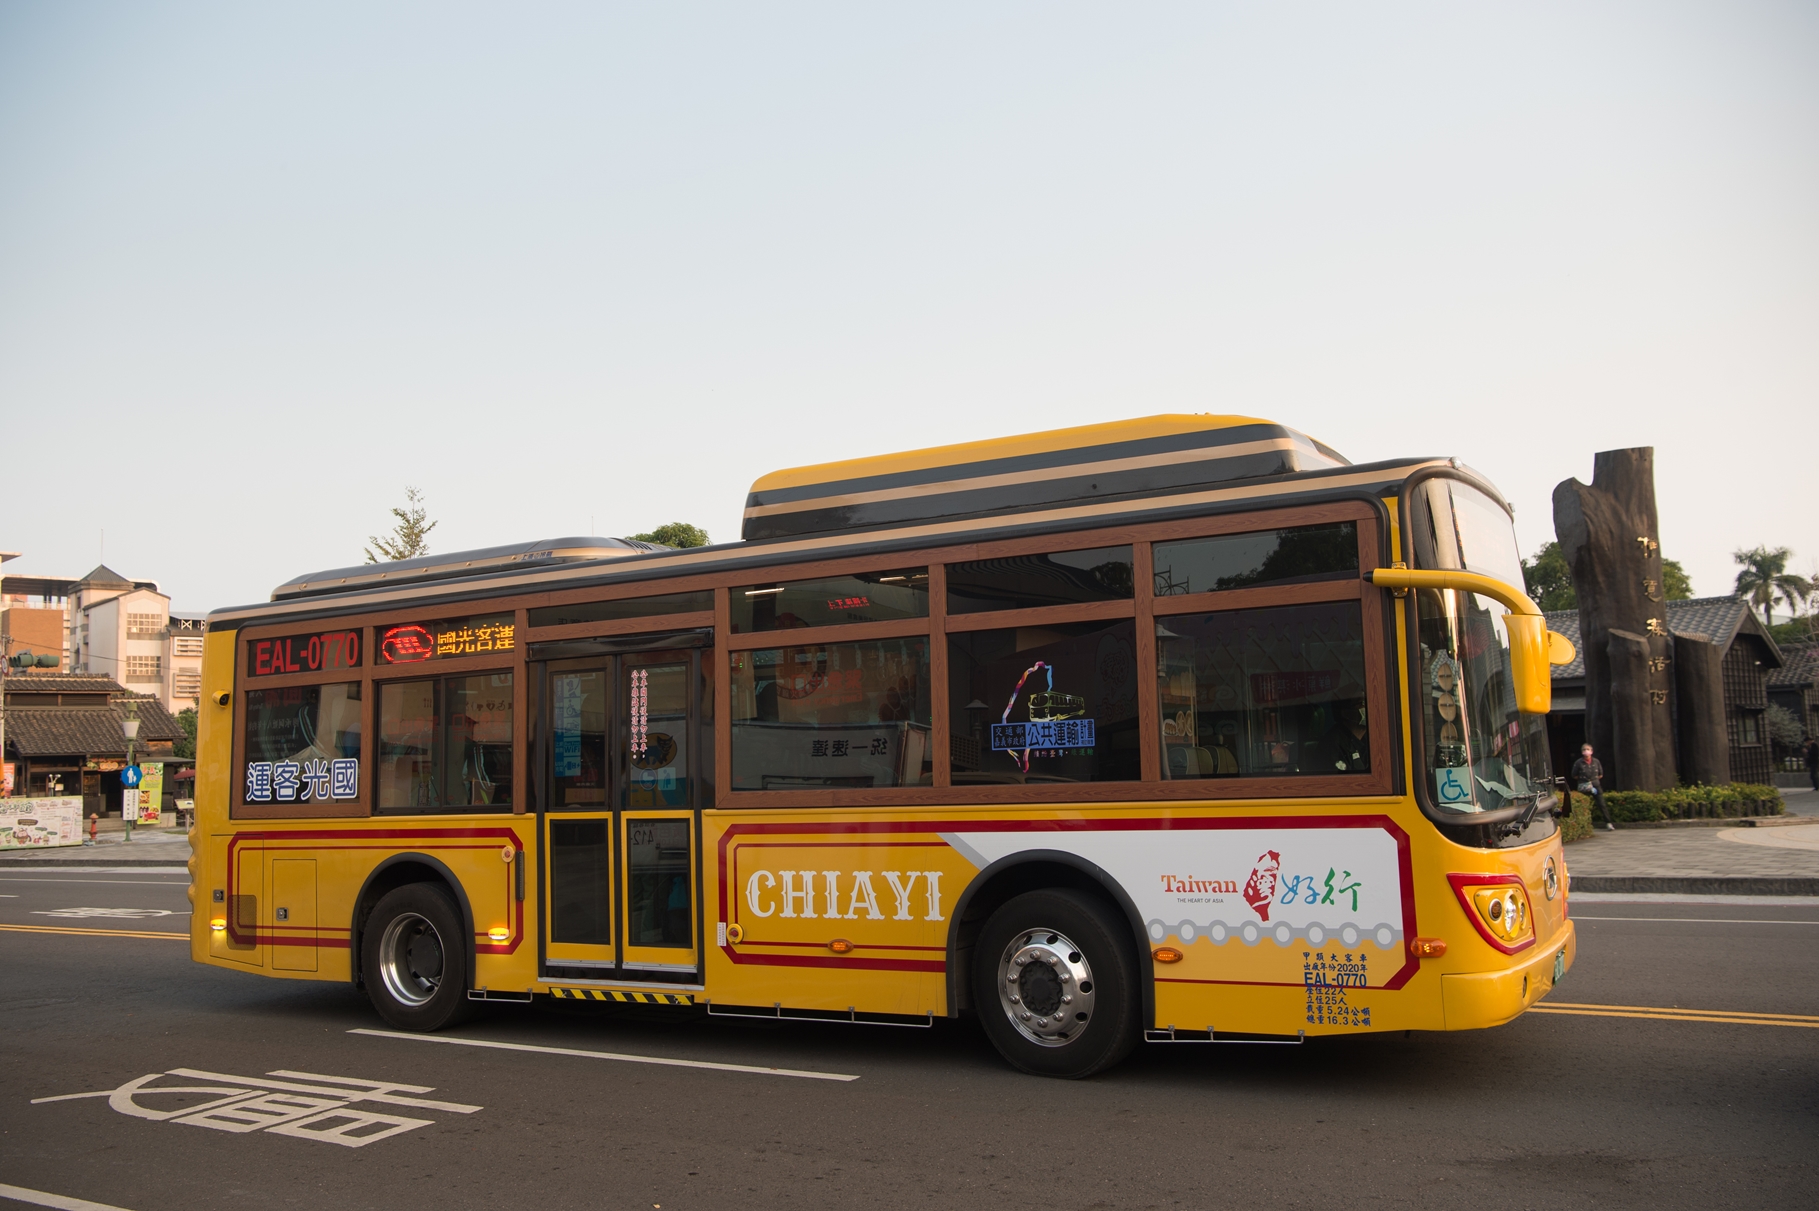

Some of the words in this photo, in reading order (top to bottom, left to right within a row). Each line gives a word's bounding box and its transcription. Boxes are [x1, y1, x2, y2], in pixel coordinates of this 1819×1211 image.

[437, 623, 515, 655] 國光客運
[255, 632, 359, 675] EAL-0770
[745, 870, 945, 921] CHIAYI
[1161, 875, 1238, 893] Taiwan
[1280, 867, 1362, 912] 好行
[1304, 972, 1367, 987] EAL-0770
[1305, 986, 1347, 995] 座位22人
[1306, 995, 1347, 1005] 立位25人
